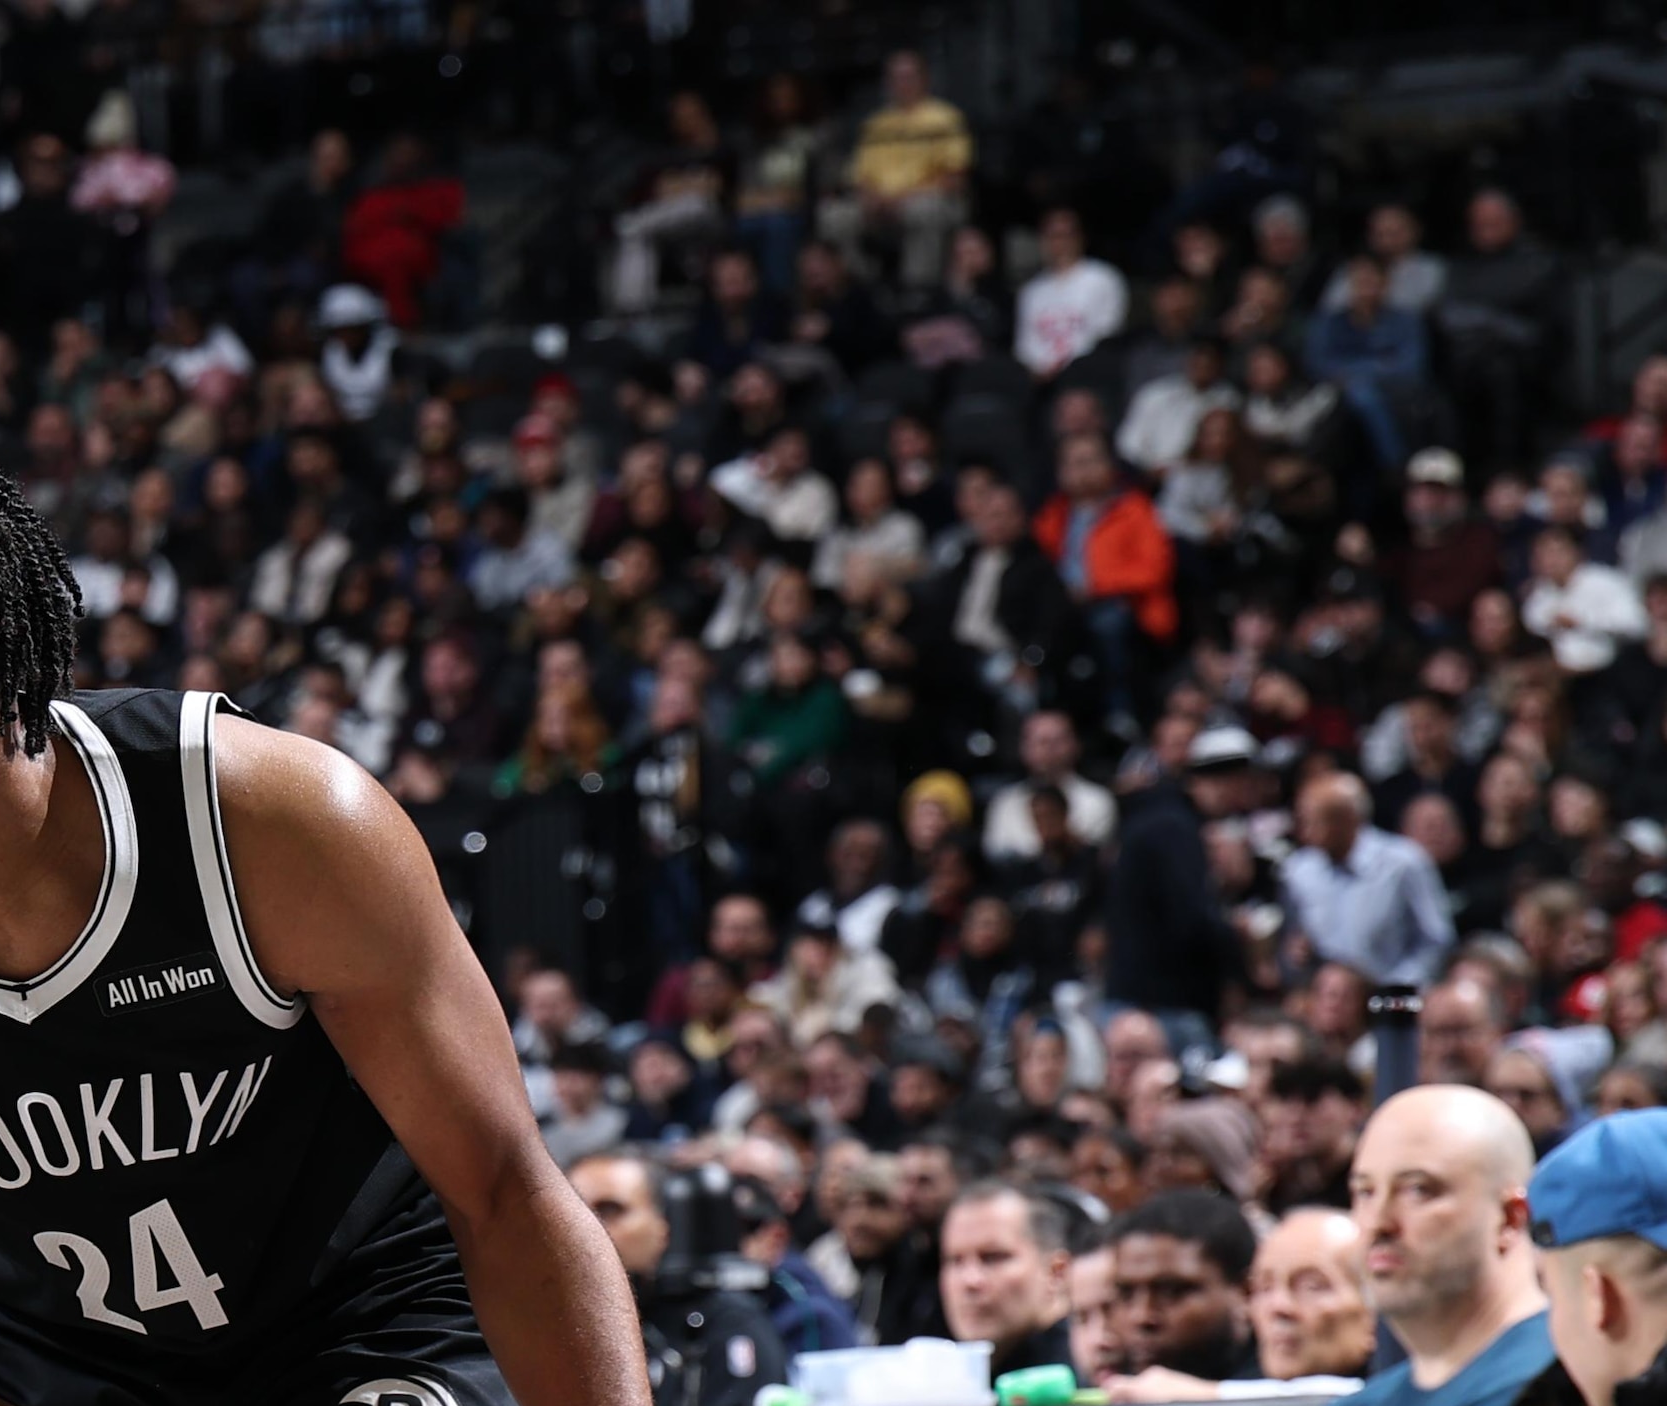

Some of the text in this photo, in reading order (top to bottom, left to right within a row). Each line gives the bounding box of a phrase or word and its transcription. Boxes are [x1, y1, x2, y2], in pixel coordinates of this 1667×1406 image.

[108, 965, 216, 1008] All In Won
[33, 1198, 230, 1336] 24
